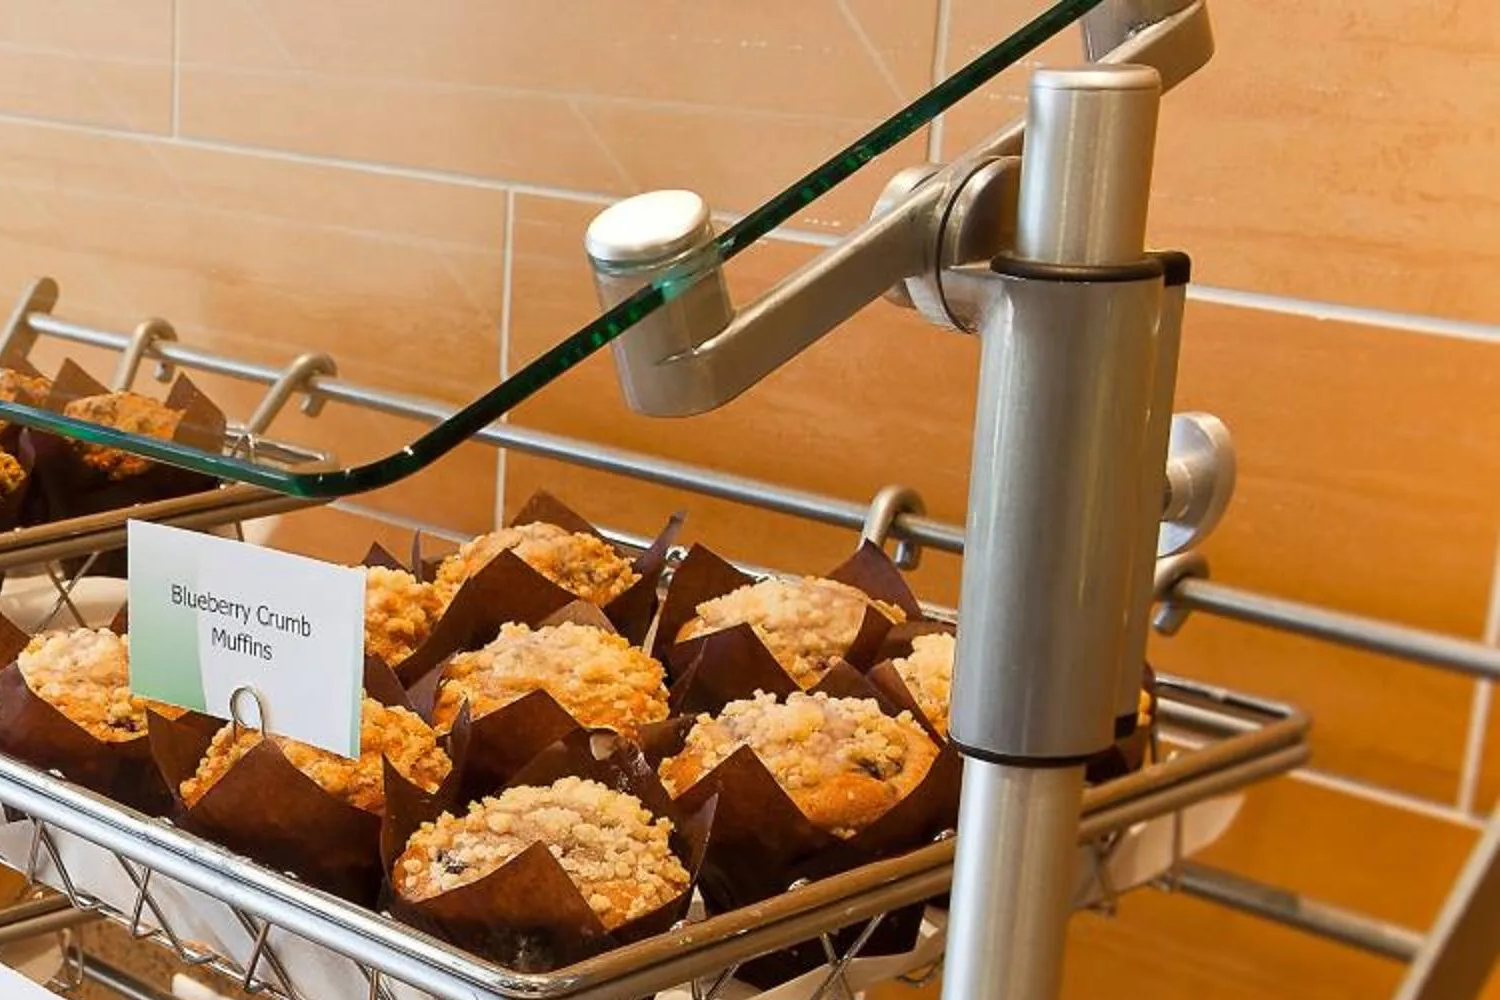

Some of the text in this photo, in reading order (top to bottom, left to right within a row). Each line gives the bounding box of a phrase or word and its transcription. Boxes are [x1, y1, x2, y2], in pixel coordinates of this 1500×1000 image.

[171, 584, 311, 637] Blueberry Crumb
[211, 626, 273, 661] Muffins
